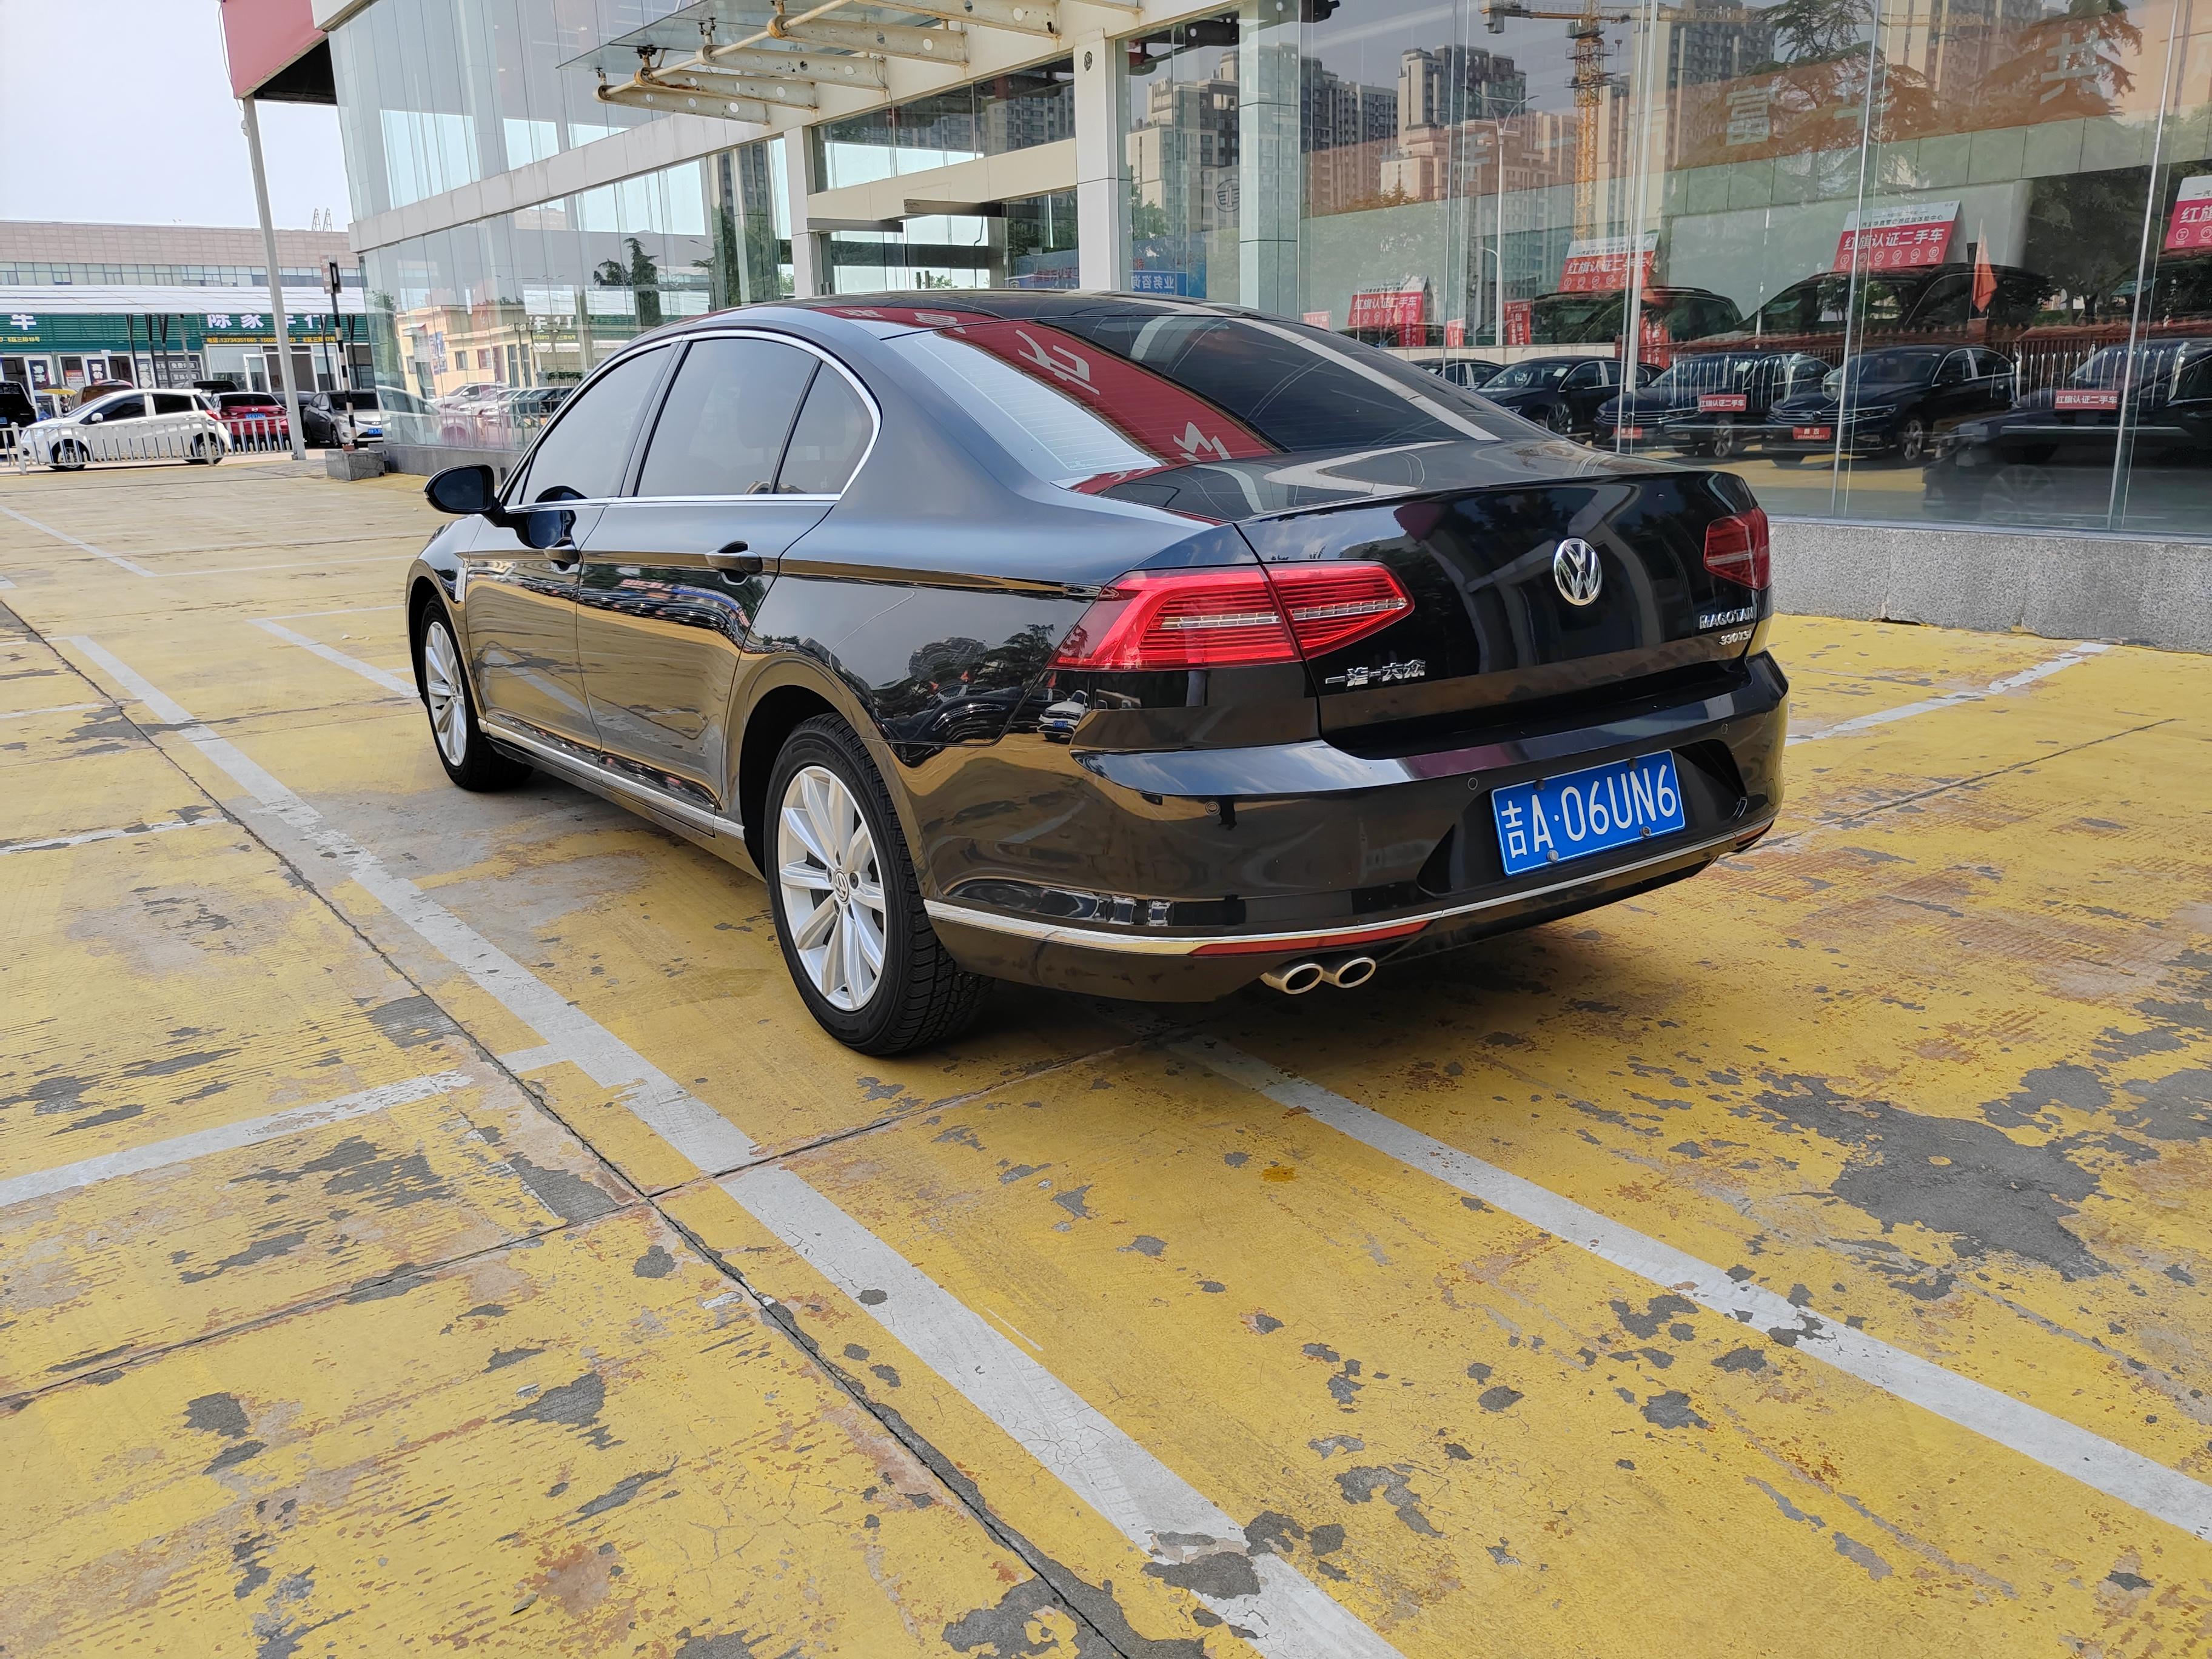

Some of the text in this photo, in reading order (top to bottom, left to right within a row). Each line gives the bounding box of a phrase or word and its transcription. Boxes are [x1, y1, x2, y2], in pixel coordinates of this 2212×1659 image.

[1843, 228, 1945, 250] 红旗认证二手车
[1354, 296, 1418, 310] 红旗认证二手车
[2056, 395, 2117, 404] 红旗认证二手车
[1699, 606, 1754, 629] MAGOTAN
